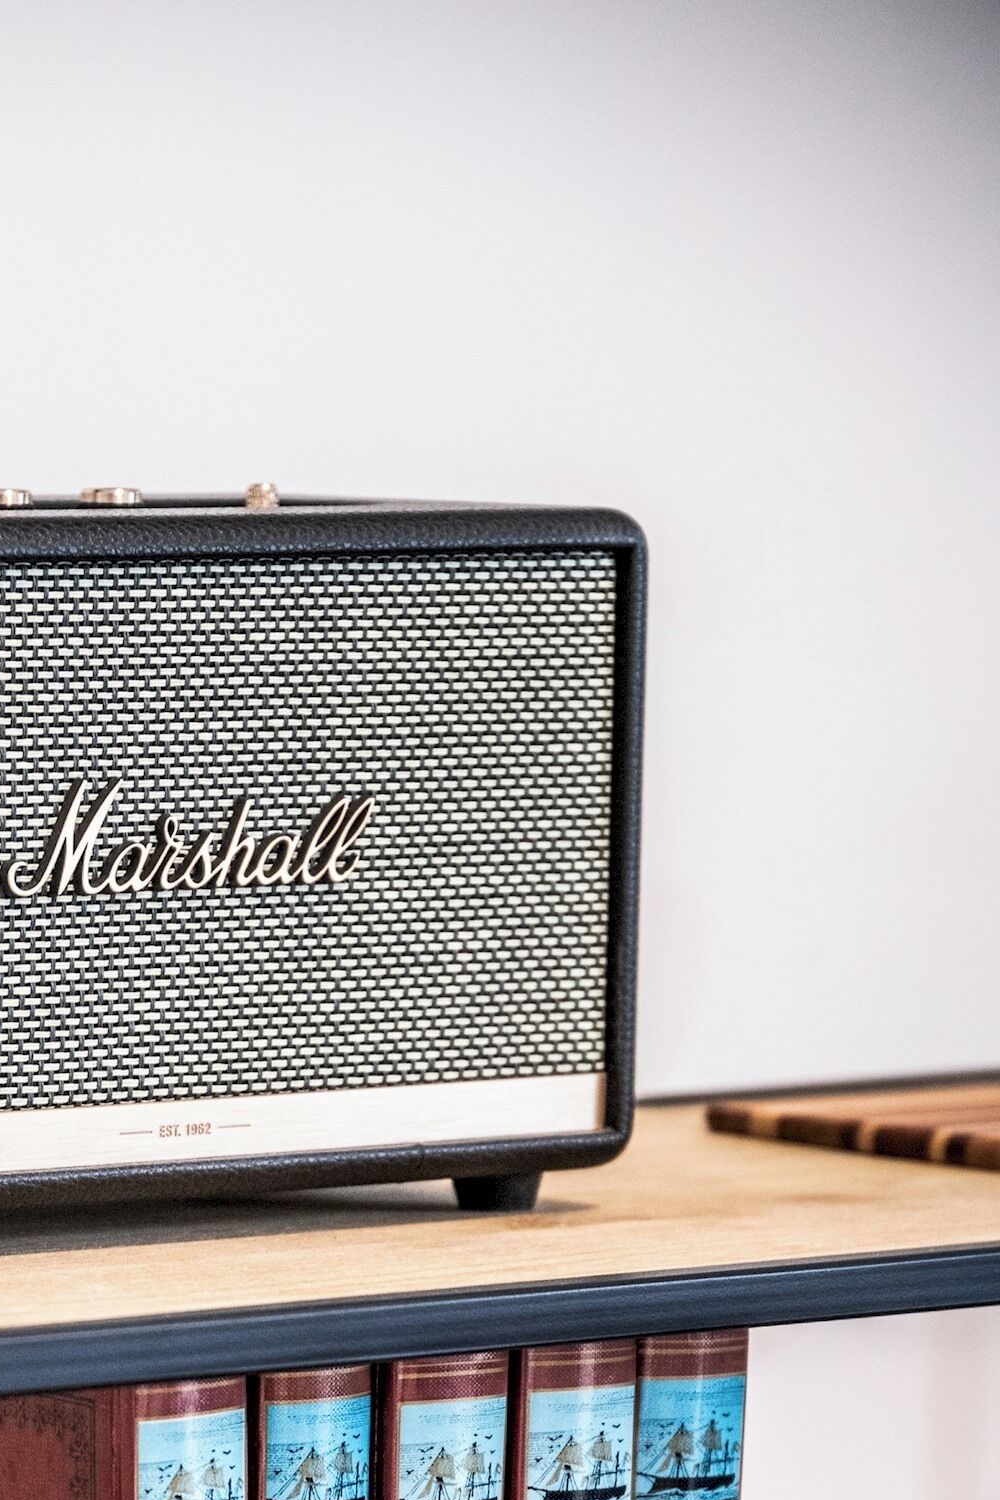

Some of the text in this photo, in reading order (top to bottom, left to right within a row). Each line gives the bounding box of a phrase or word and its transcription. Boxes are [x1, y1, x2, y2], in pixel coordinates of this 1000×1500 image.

[2, 778, 375, 897] Marshall
[159, 1122, 212, 1138] EST. 1962
